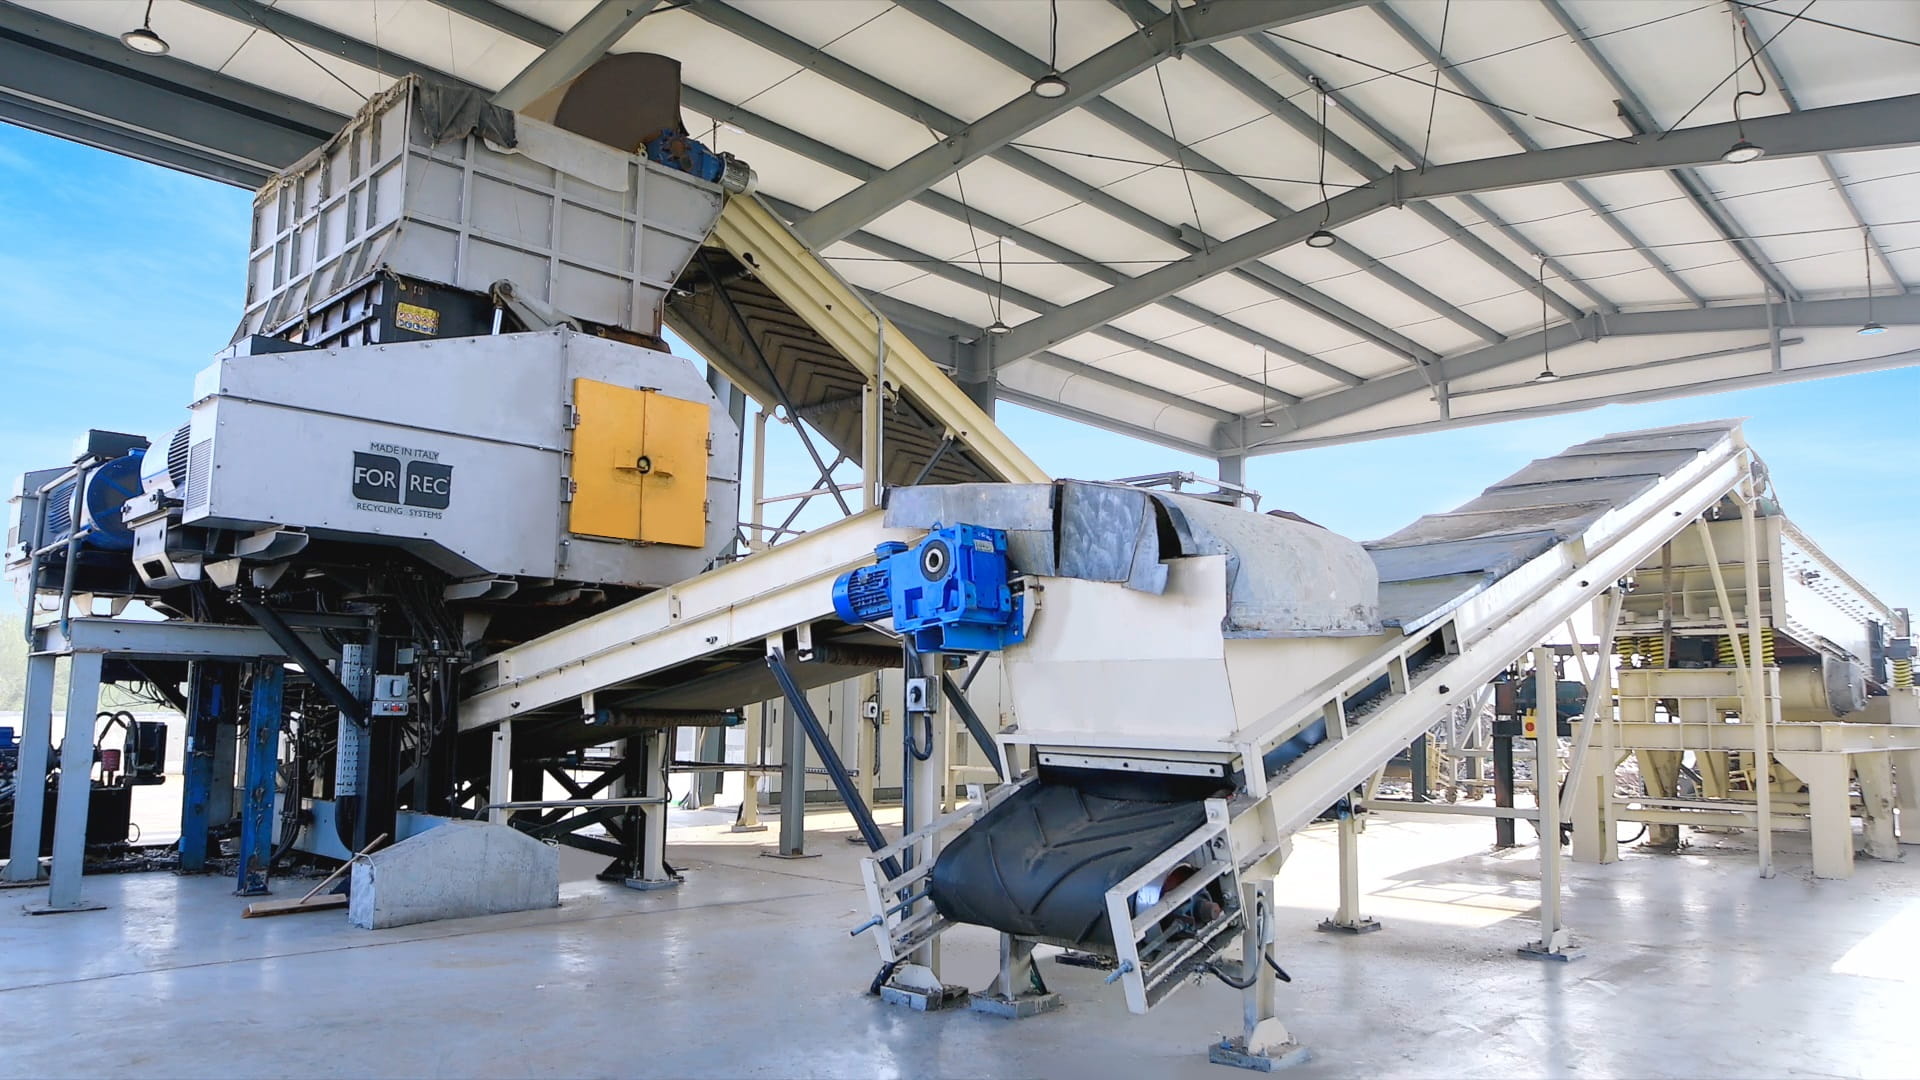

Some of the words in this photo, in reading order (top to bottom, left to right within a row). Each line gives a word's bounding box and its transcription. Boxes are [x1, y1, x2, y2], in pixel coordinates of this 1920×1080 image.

[370, 442, 400, 455] MADE
[401, 447, 413, 457] IN
[414, 449, 440, 460] ITALY
[354, 466, 397, 489] FOR
[410, 474, 448, 495] REC
[356, 502, 403, 515] RECYCLING
[409, 508, 443, 520] SYSTEMS
